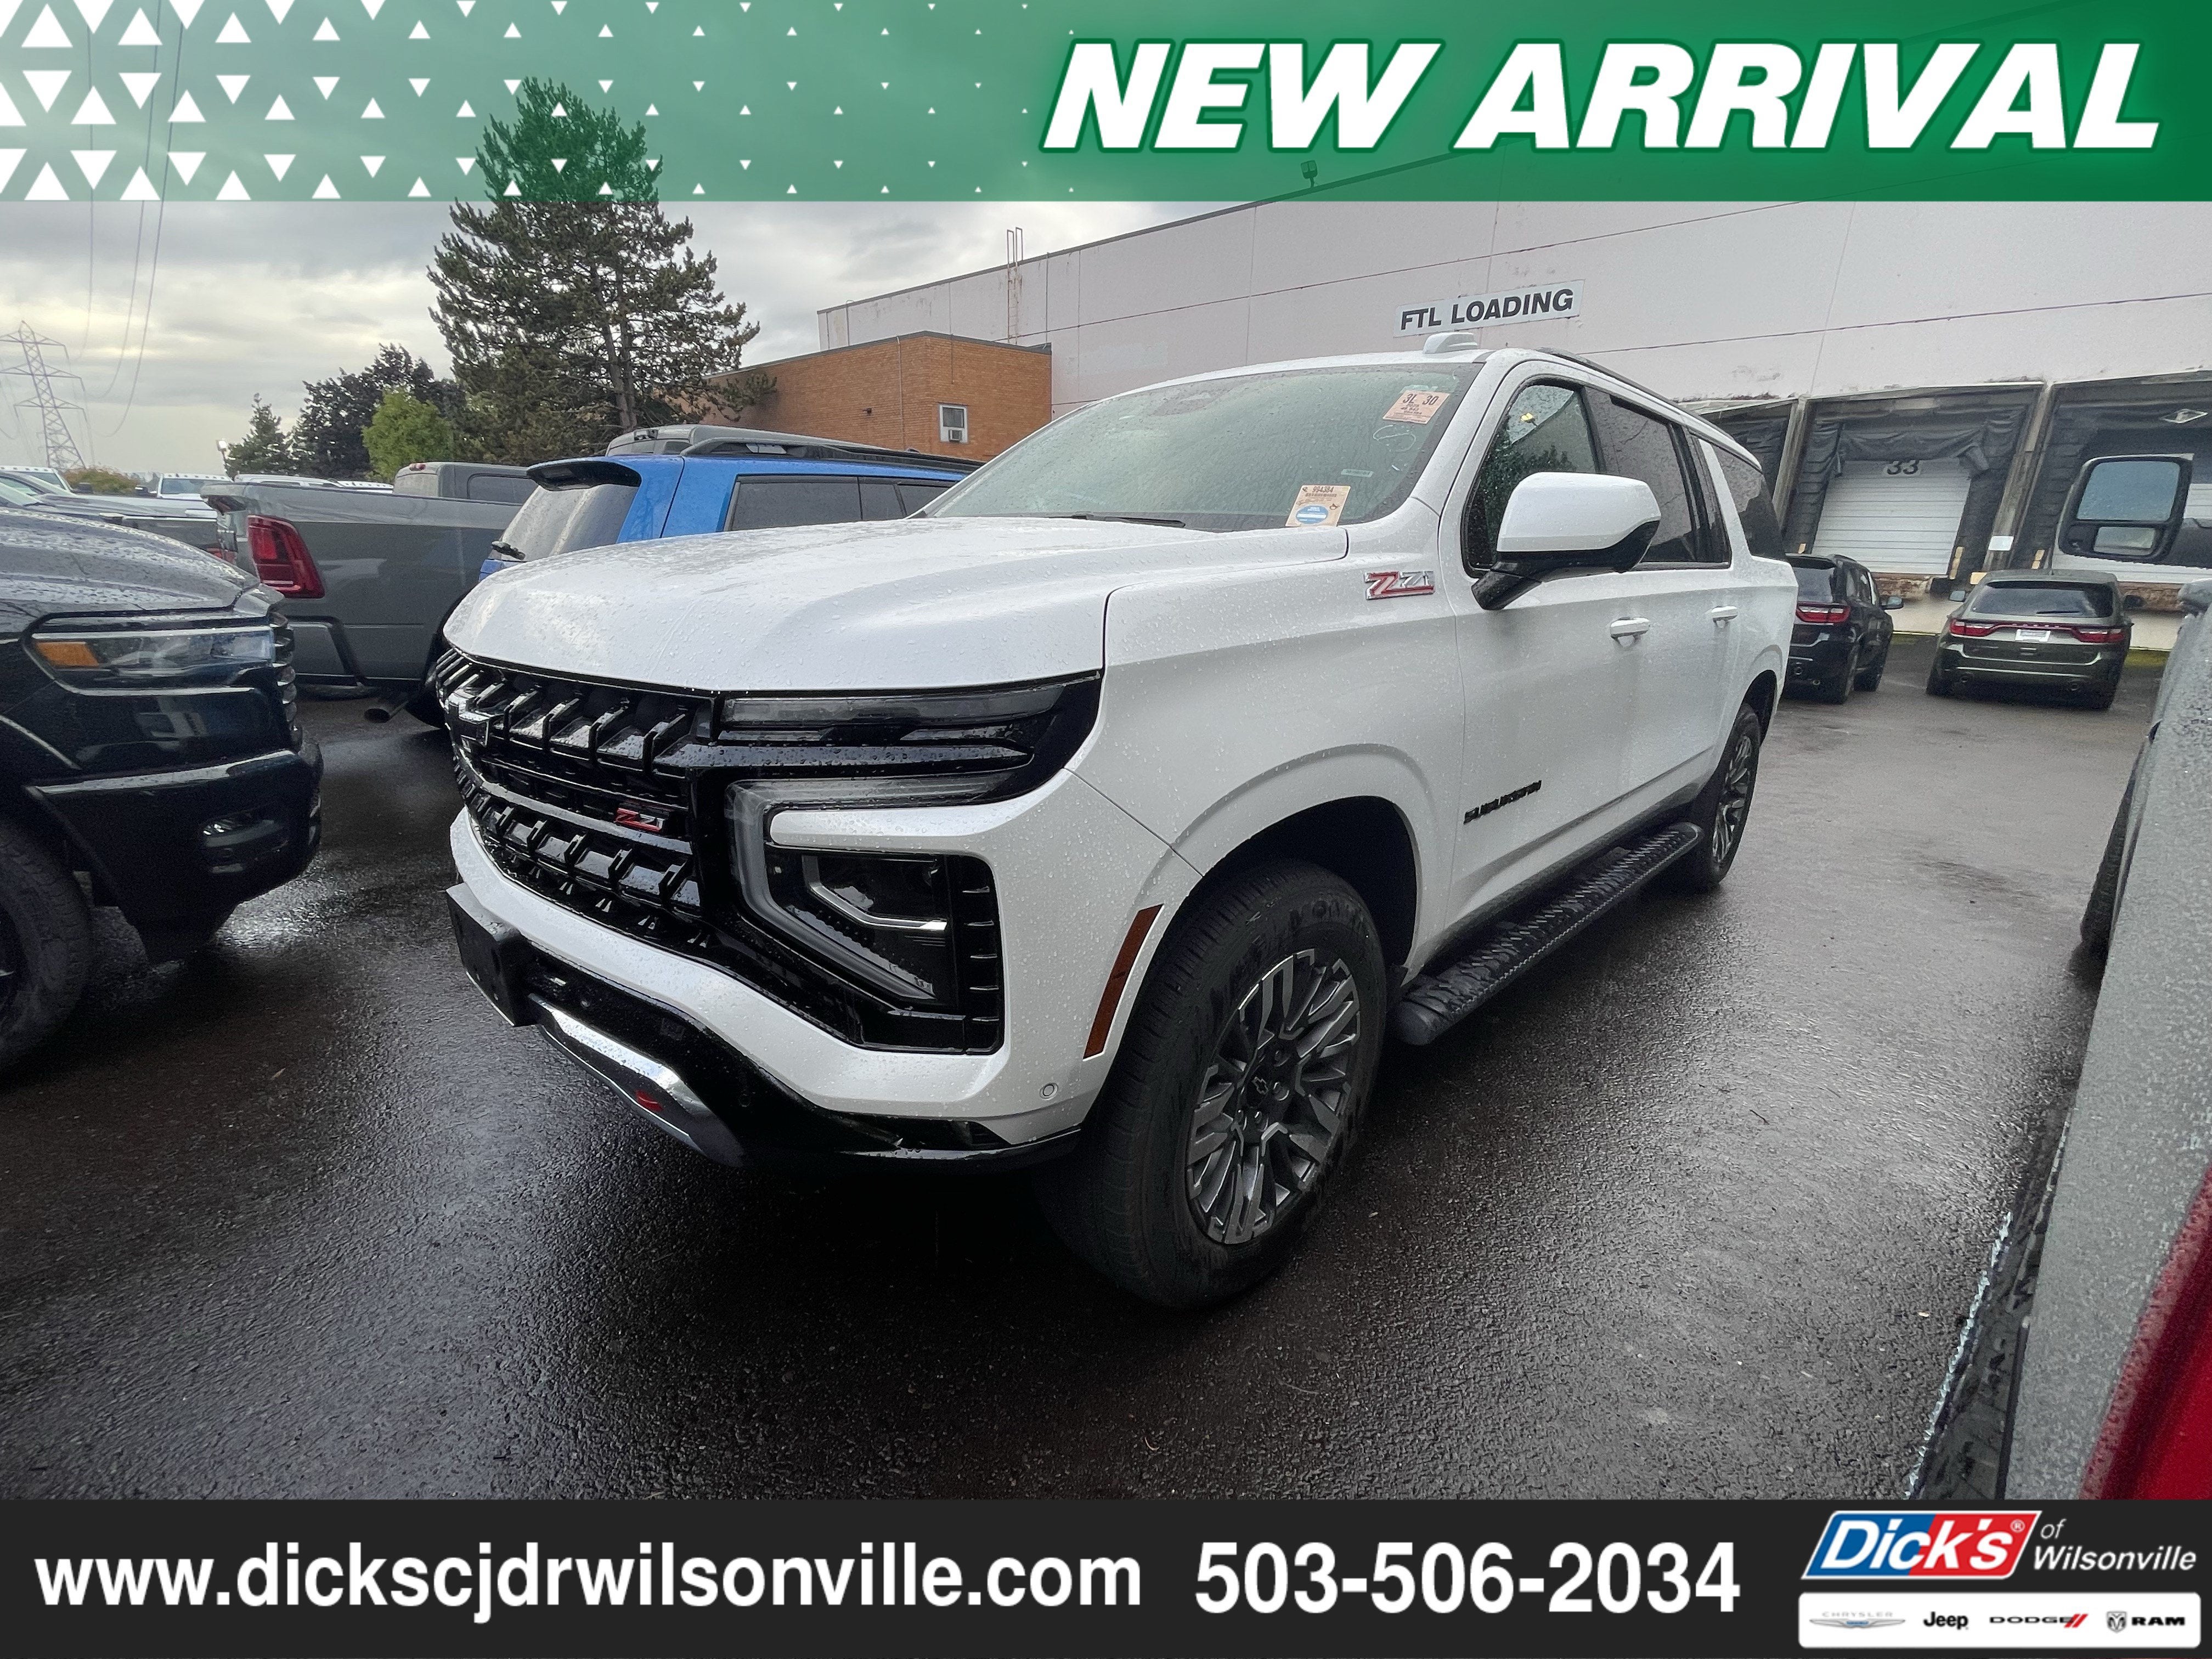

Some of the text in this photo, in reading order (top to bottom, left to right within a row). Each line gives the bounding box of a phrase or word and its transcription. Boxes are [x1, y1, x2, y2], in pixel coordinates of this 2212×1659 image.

[1401, 289, 1573, 330] FTL LOADING
[1422, 395, 1439, 405] 30
[1887, 460, 1919, 475] 33
[1363, 571, 1435, 600] Z71
